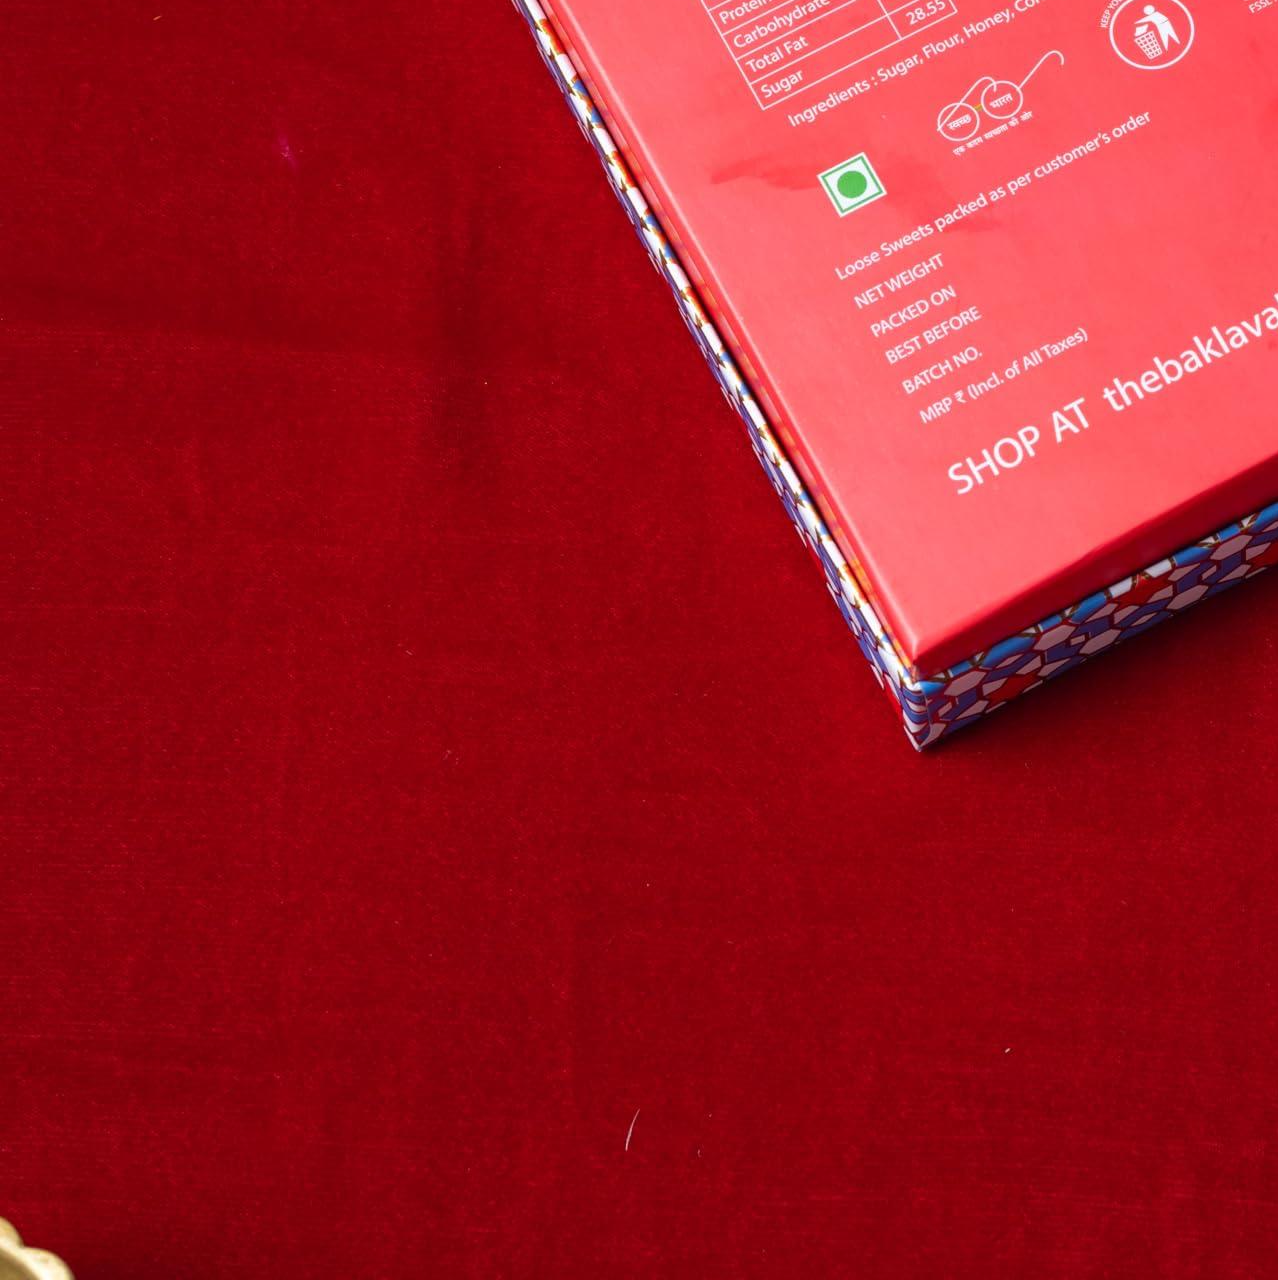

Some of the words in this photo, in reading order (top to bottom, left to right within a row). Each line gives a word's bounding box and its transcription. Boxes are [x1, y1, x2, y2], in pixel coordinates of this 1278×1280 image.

[745, 46, 784, 72] Total
[783, 36, 809, 55] Fat
[787, 79, 871, 127] Ingredients
[876, 54, 924, 82] Sugar,
[921, 33, 965, 59] Flour,
[962, 8, 1015, 39] Honey,
[760, 70, 803, 99] Sugar
[834, 251, 881, 281] Loose
[880, 223, 934, 257] Sweets
[934, 192, 988, 233] packed
[988, 186, 1007, 202] as
[1006, 172, 1032, 196] per
[1111, 111, 1151, 139] order
[853, 283, 885, 309] NET
[883, 252, 944, 292] WEIGHT
[870, 299, 930, 338] PACKED
[930, 284, 957, 306] ON
[885, 335, 922, 365] BEST
[922, 305, 982, 345] BEFORE
[901, 359, 954, 395] BATCH
[952, 346, 983, 368] NO.
[919, 396, 953, 424] MRP
[967, 371, 1005, 400] (Incl.
[1004, 359, 1021, 380] of
[1022, 349, 1043, 371] All
[1039, 327, 1089, 358] Taxes)
[948, 425, 1040, 495] SHOP
[1051, 397, 1090, 443] AT
